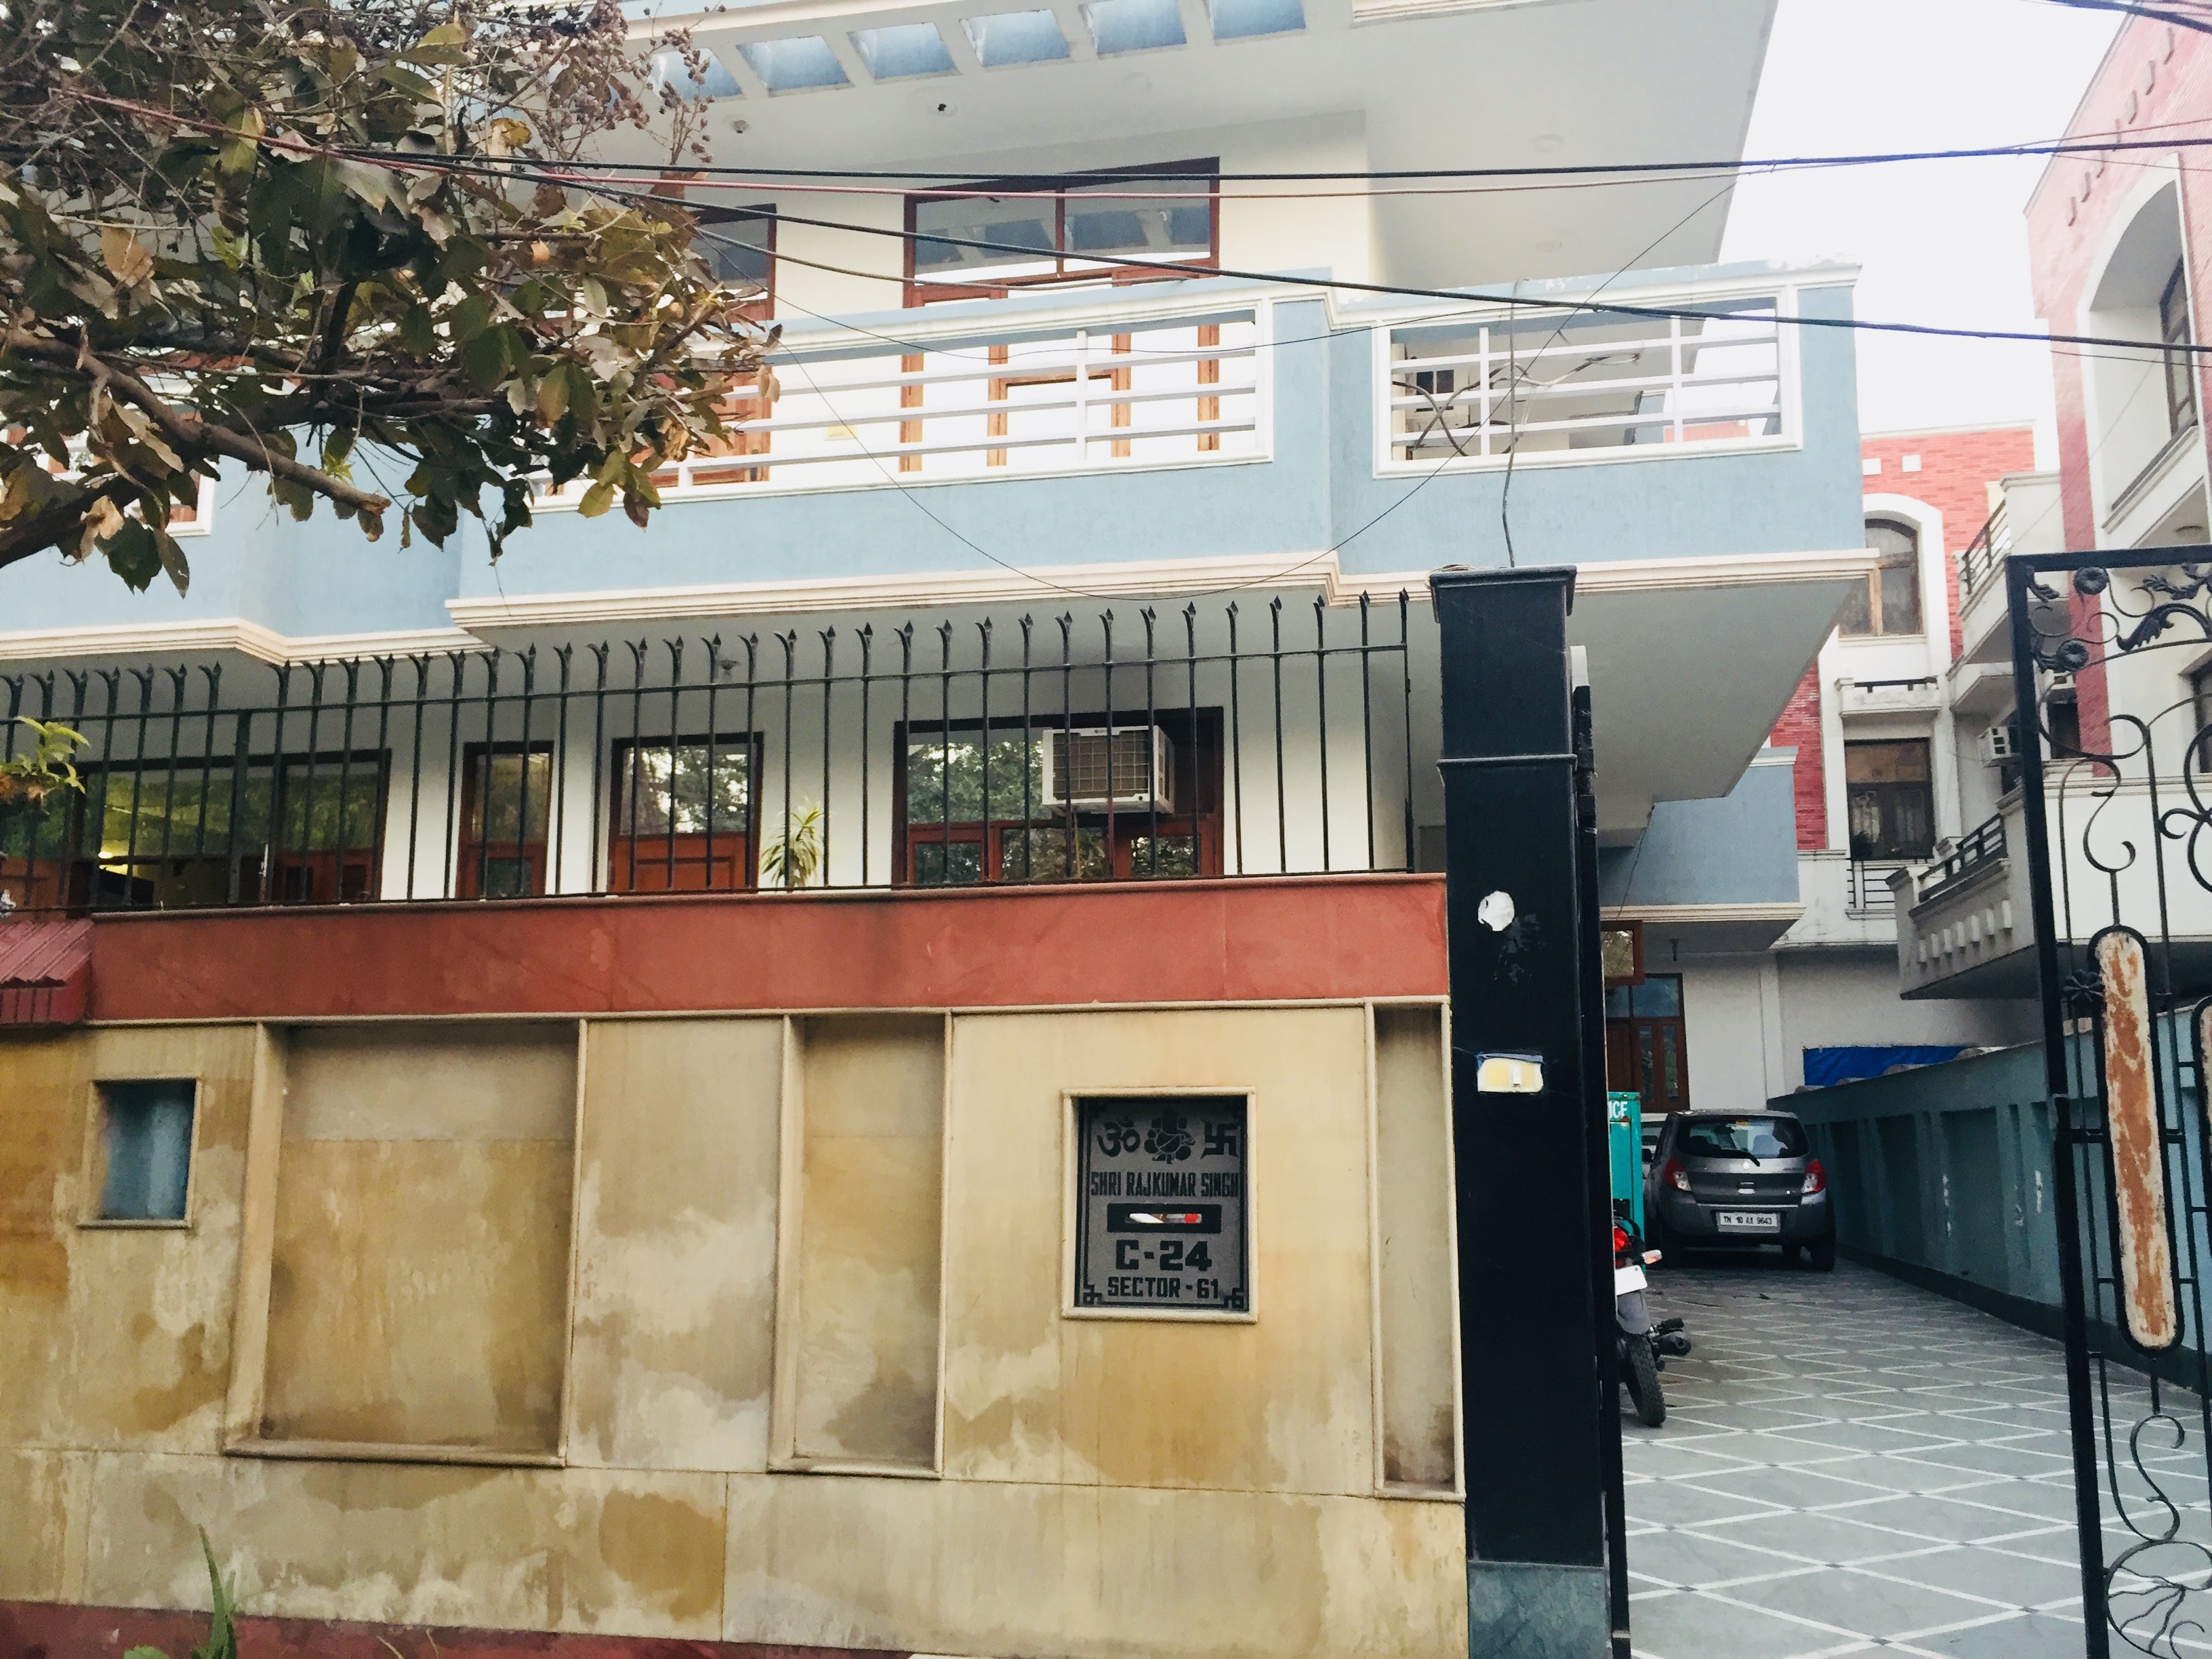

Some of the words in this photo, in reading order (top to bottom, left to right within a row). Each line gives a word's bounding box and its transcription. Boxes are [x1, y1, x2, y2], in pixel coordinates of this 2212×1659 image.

[1091, 1172, 1121, 1196] SHRI
[1126, 1172, 1196, 1197] RAJKUMAR
[1201, 1172, 1240, 1197] SINGH
[1723, 1216, 1732, 1224] TN
[1116, 1240, 1212, 1271] C-24
